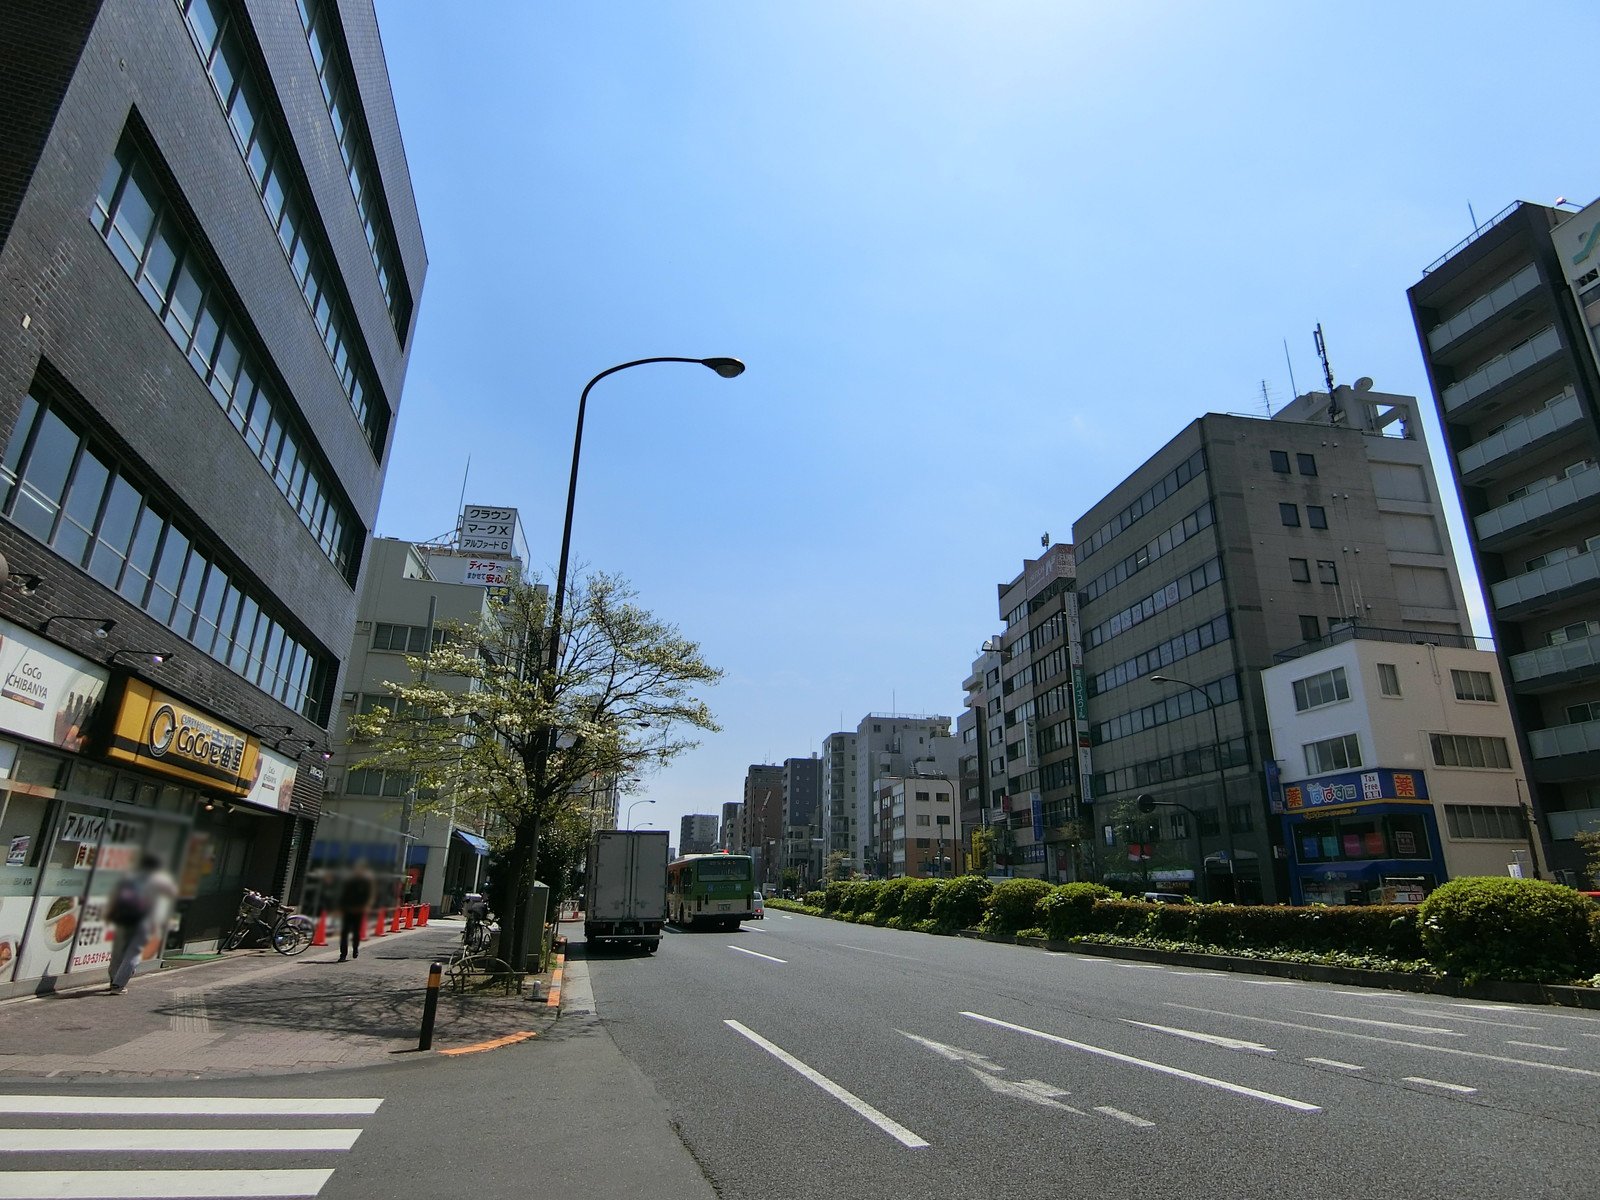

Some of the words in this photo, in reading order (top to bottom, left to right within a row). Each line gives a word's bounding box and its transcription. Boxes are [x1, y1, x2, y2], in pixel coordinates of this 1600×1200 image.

[470, 509, 512, 520] クラウン
[22, 663, 42, 680] CoCo
[5, 673, 48, 699] ICHIBANYA
[1364, 774, 1376, 783] Tax
[1364, 783, 1379, 791] Free
[1395, 775, 1414, 796] 薬
[1287, 788, 1302, 807] 薬
